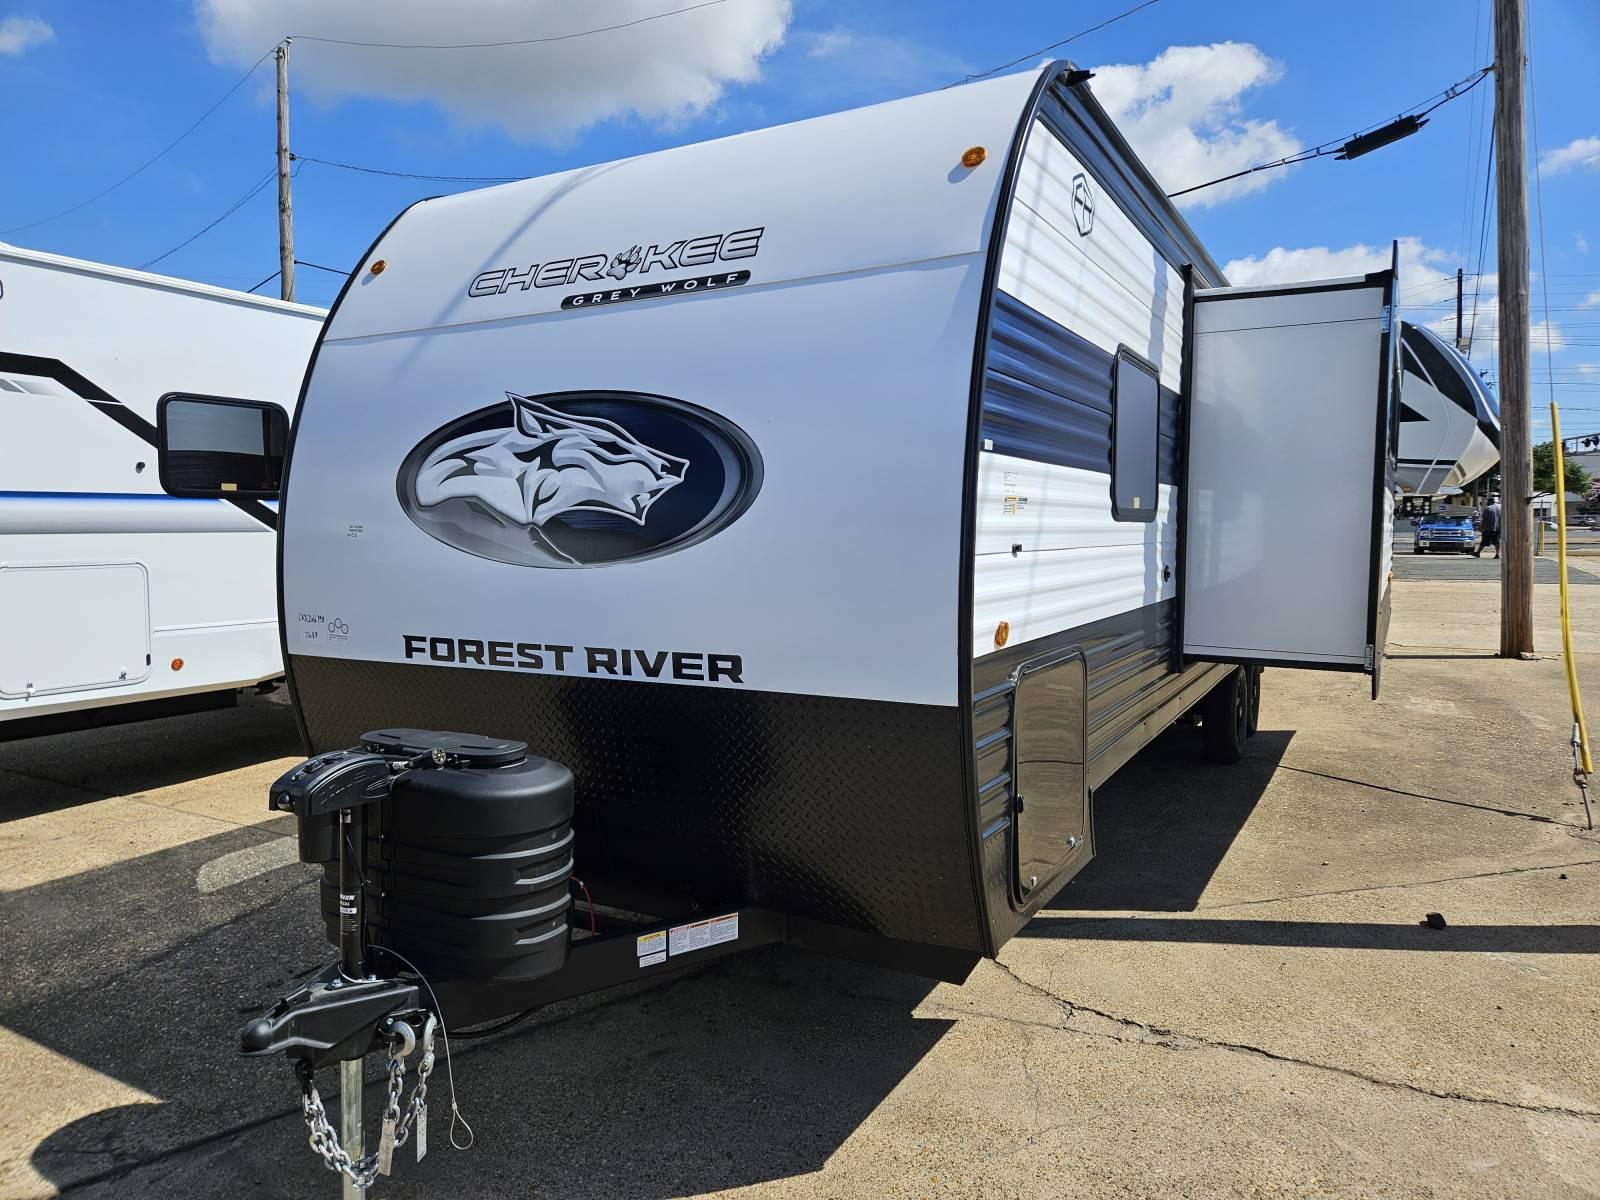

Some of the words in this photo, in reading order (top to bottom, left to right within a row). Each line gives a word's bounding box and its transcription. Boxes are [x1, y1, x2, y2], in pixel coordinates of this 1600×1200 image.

[572, 287, 641, 306] GREY
[661, 273, 740, 293] WOLF
[402, 635, 573, 671] FOREST
[583, 647, 743, 683] RIVER
